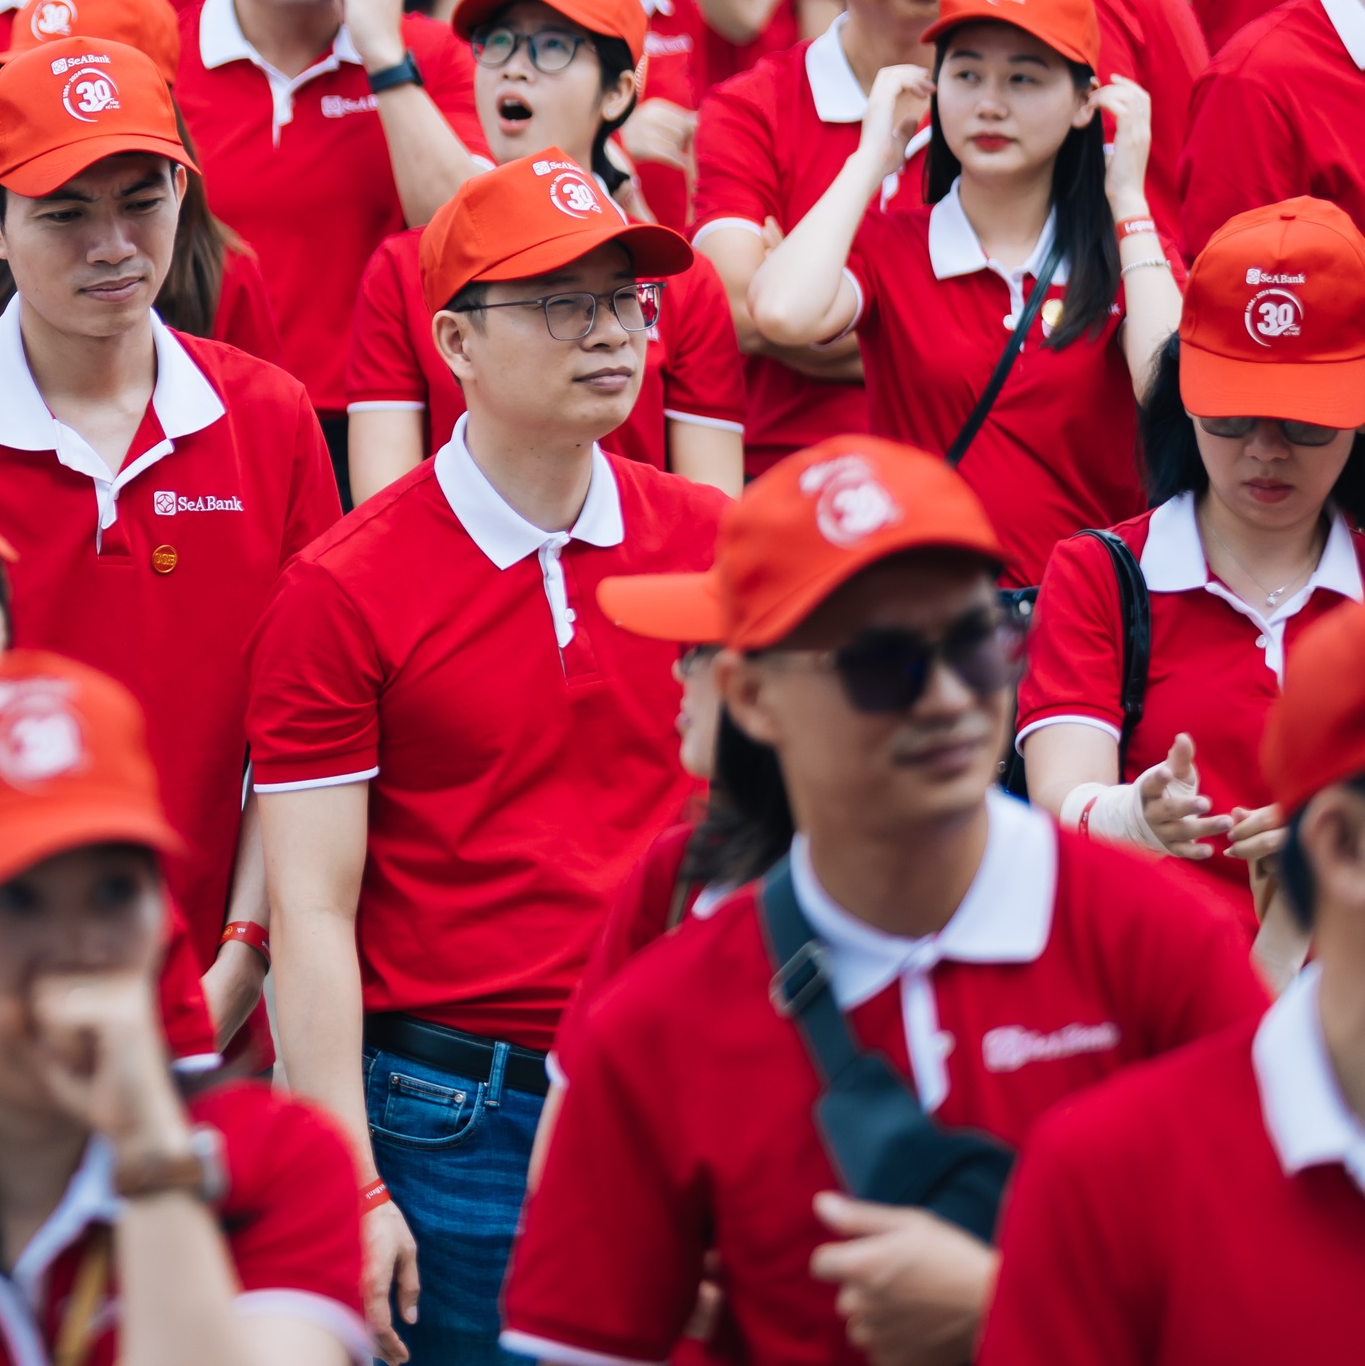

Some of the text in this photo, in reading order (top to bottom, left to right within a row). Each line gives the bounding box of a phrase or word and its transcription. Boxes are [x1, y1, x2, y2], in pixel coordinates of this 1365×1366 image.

[68, 54, 111, 67] SeABank
[76, 79, 114, 112] 30
[562, 183, 596, 211] 30
[1260, 273, 1305, 285] SeABank
[1257, 302, 1296, 337] 30
[177, 492, 244, 513] SeABank
